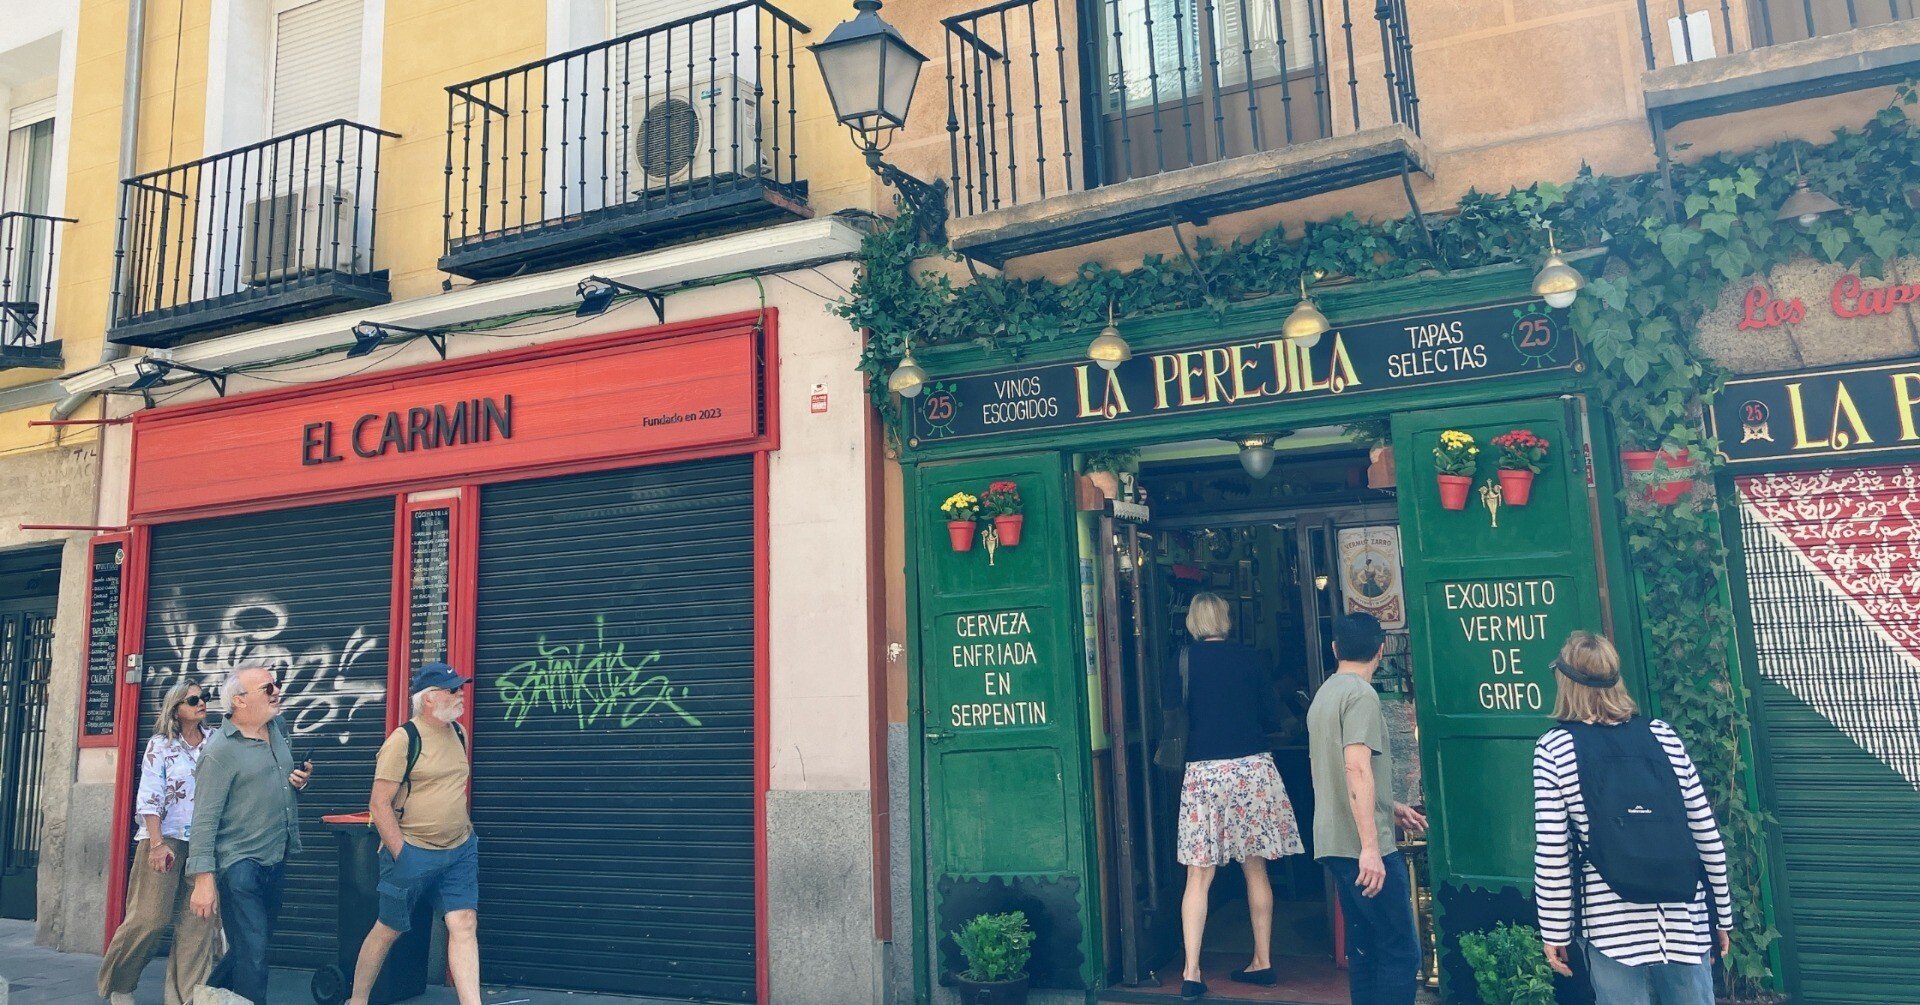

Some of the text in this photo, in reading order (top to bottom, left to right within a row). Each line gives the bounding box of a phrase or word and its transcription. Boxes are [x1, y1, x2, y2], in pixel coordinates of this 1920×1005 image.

[1738, 286, 1806, 331] Los
[1403, 321, 1464, 347] TAPAS
[1518, 318, 1551, 350] 25
[1387, 345, 1487, 379] SELECTAS
[994, 375, 1041, 399] VINOS
[1073, 331, 1362, 420] LA PEREJILA
[643, 407, 722, 428] Fundado en 2023
[927, 395, 952, 421] 25
[982, 396, 1058, 425] ESCOGIDOS
[1746, 405, 1763, 421] 25
[1785, 380, 1875, 450] LA
[302, 394, 514, 466] EL CARMIN
[1371, 539, 1392, 547] ZARRO
[1444, 580, 1555, 610] EXQUISITO
[957, 612, 1031, 637] CERVEZA
[1460, 614, 1548, 642] VERMUT
[953, 642, 1037, 668] ENFRIADA
[1492, 649, 1524, 675] DE
[985, 672, 1011, 696] EN
[1479, 682, 1542, 710] GRIFO
[951, 701, 1046, 727] SERPENTIN
